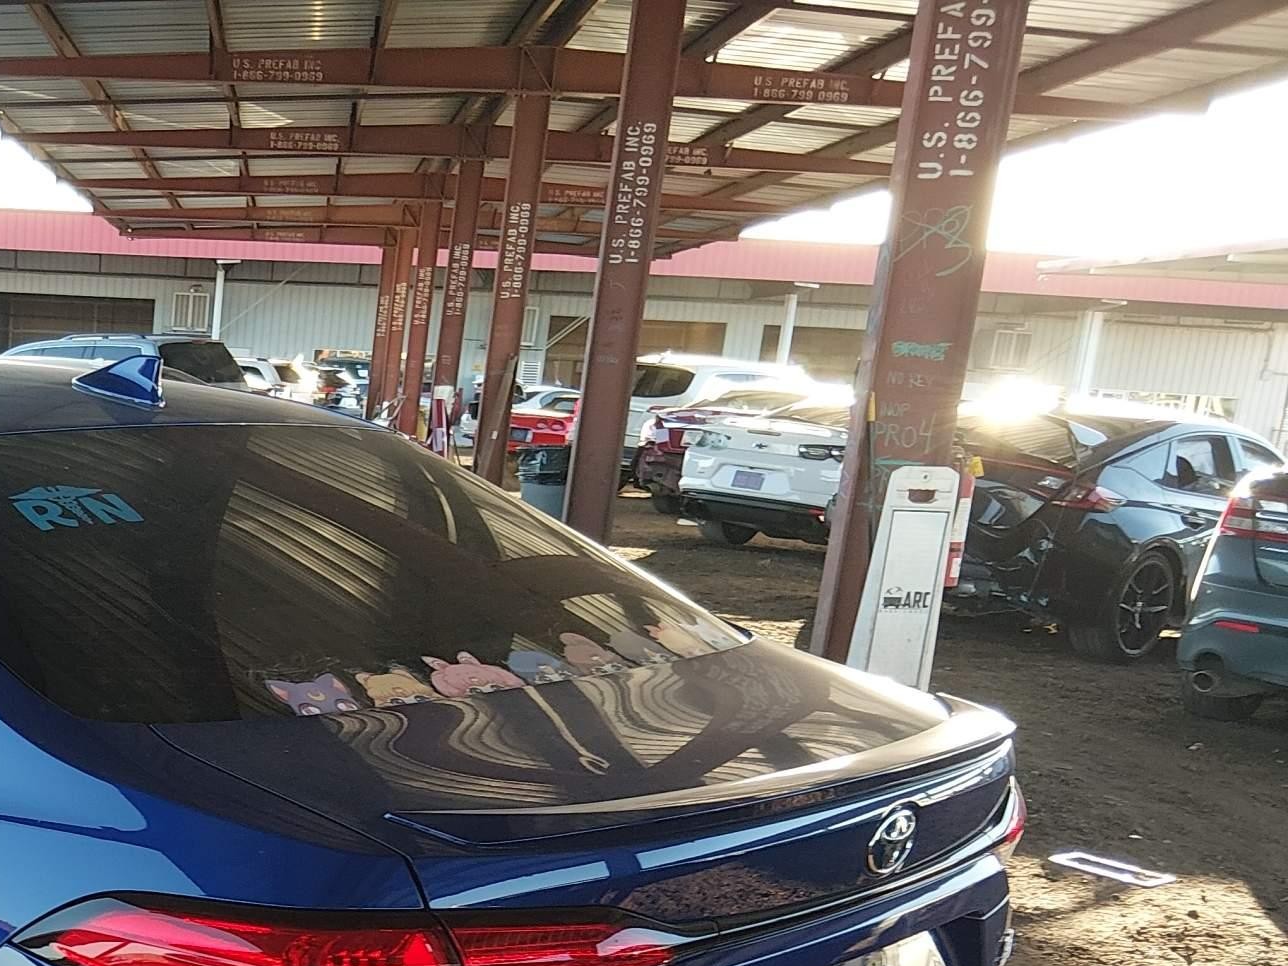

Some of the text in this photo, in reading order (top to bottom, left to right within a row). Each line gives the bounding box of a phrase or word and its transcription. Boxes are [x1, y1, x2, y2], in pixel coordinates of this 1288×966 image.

[780, 77, 825, 89] PREFAB
[928, 0, 966, 102] PREFA
[917, 122, 949, 180] U.S.
[608, 121, 642, 264] U.S. PREFAB INC.
[624, 123, 657, 263] 1-866-799-0969
[902, 591, 931, 609] ARC
